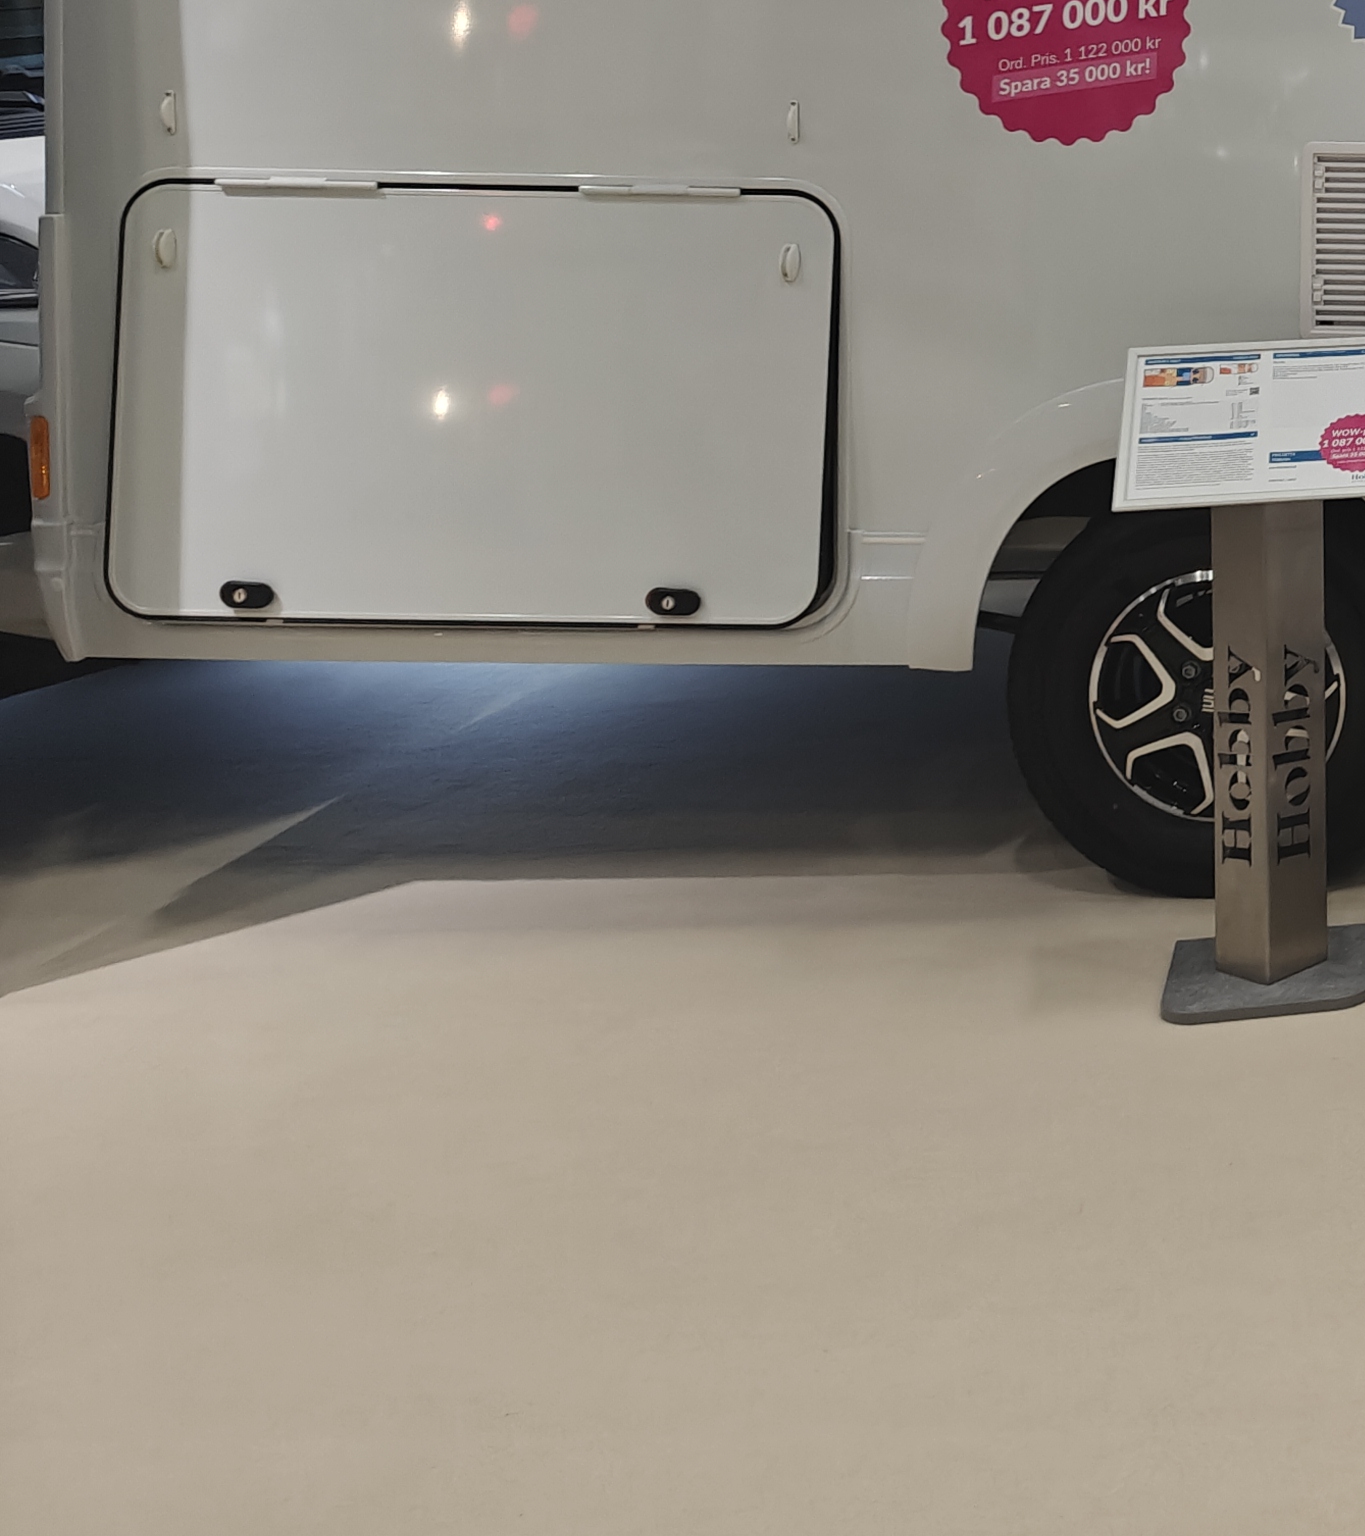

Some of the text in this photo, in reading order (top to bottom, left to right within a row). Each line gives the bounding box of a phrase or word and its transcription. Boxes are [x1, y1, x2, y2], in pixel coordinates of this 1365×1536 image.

[957, 15, 977, 46] 1
[987, 3, 1054, 41] 087
[998, 57, 1026, 72] Ord.
[1064, 48, 1072, 62] 1
[1078, 42, 1107, 60] 122
[1111, 38, 1141, 55] 000
[1146, 35, 1162, 50] kr
[999, 58, 1151, 97] Spara 35 000 kr!
[1331, 437, 1354, 447] 087
[1217, 645, 1261, 868] Hobby
[1272, 644, 1320, 866] Hobby
